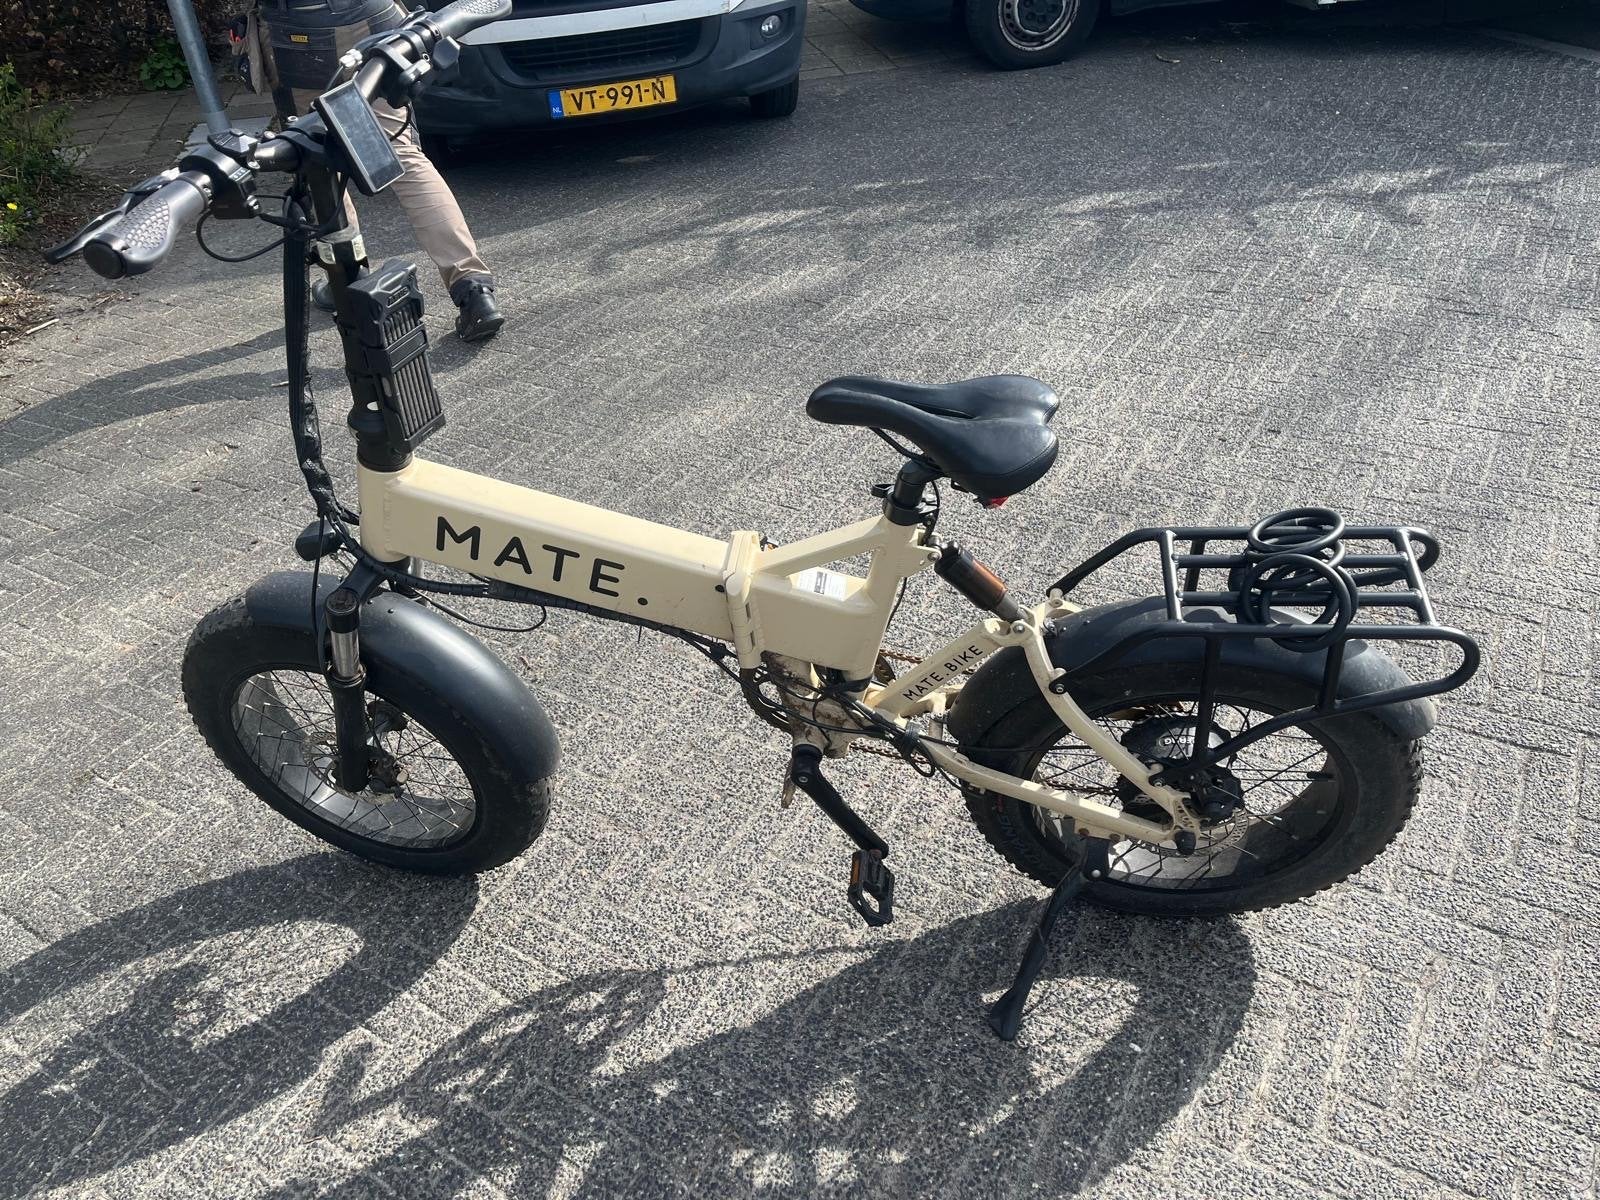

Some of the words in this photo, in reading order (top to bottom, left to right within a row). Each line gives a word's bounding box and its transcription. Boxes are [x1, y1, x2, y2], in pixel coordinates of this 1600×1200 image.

[570, 80, 666, 112] VT-991-N
[436, 516, 649, 606] MATE.
[902, 645, 984, 701] MATE.BIKE
